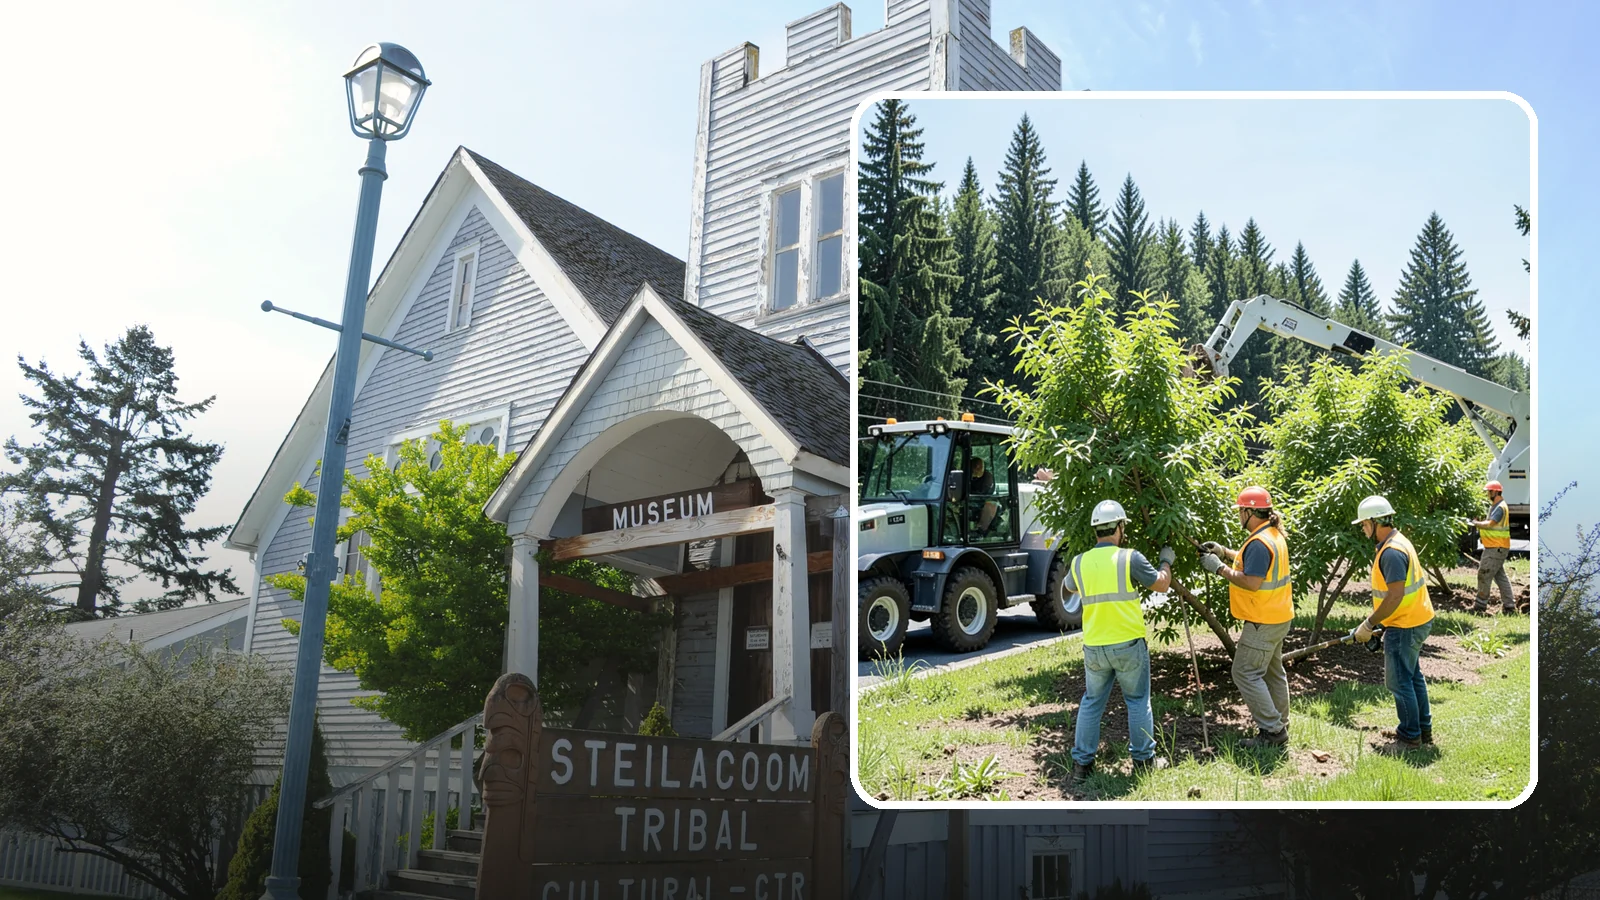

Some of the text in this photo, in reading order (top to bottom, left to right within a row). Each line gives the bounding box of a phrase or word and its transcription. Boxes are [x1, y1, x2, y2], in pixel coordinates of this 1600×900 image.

[612, 491, 714, 531] MUSEUM
[550, 738, 810, 793] STEILACOOM
[614, 806, 758, 852] TRIBAL
